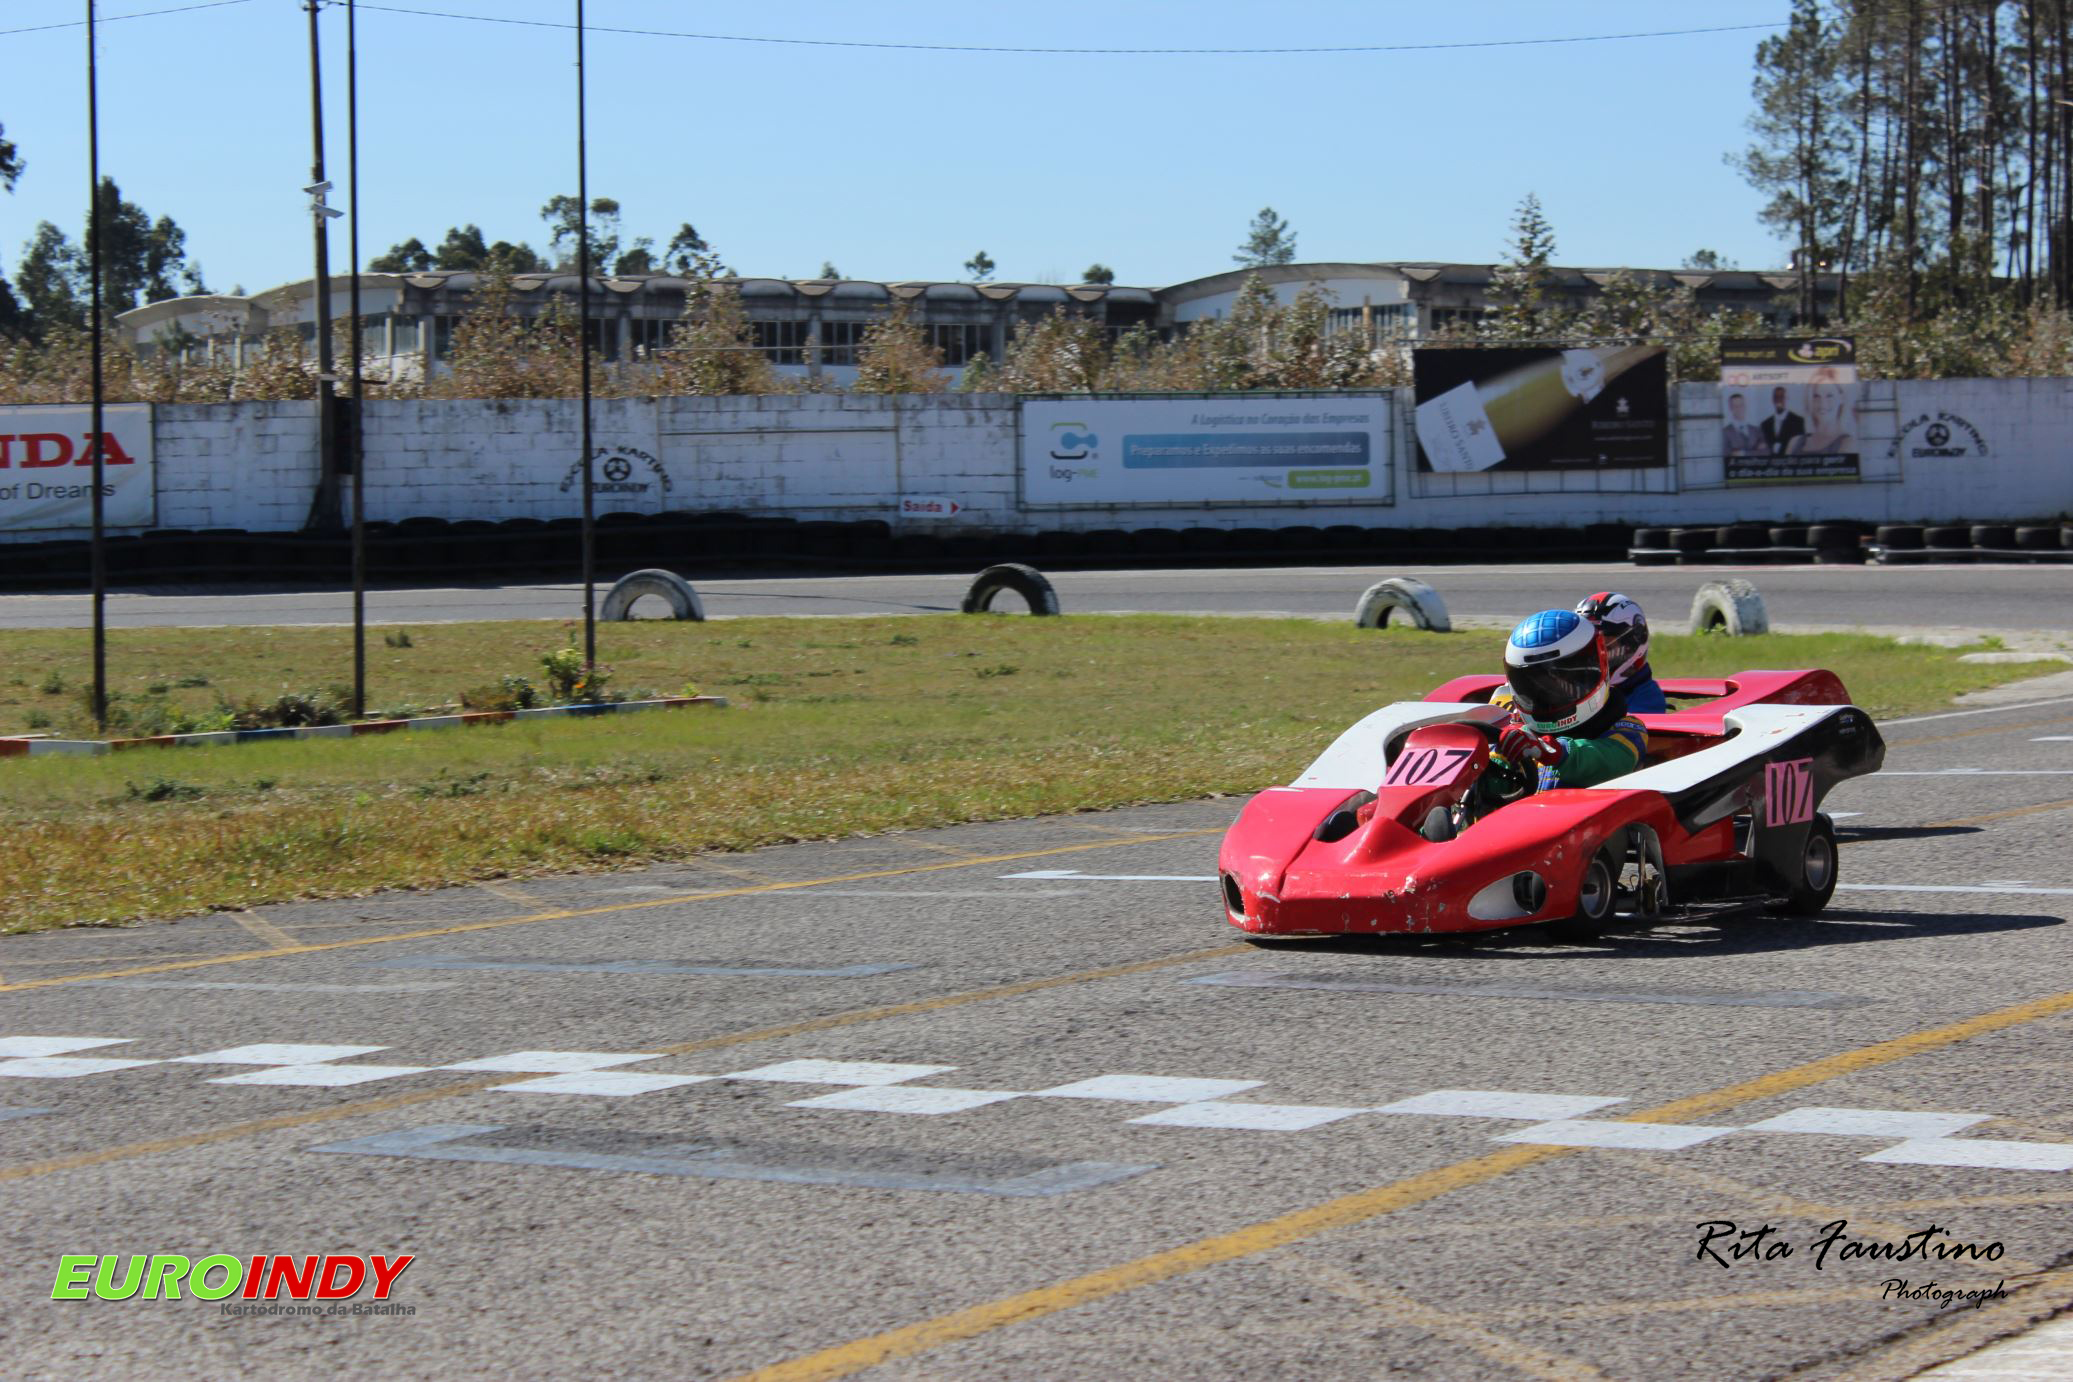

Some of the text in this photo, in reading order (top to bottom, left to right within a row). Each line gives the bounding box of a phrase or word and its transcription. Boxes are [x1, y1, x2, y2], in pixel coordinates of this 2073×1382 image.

[559, 448, 609, 493] ESCA
[1387, 749, 1473, 786] 107
[1771, 762, 1813, 825] 107
